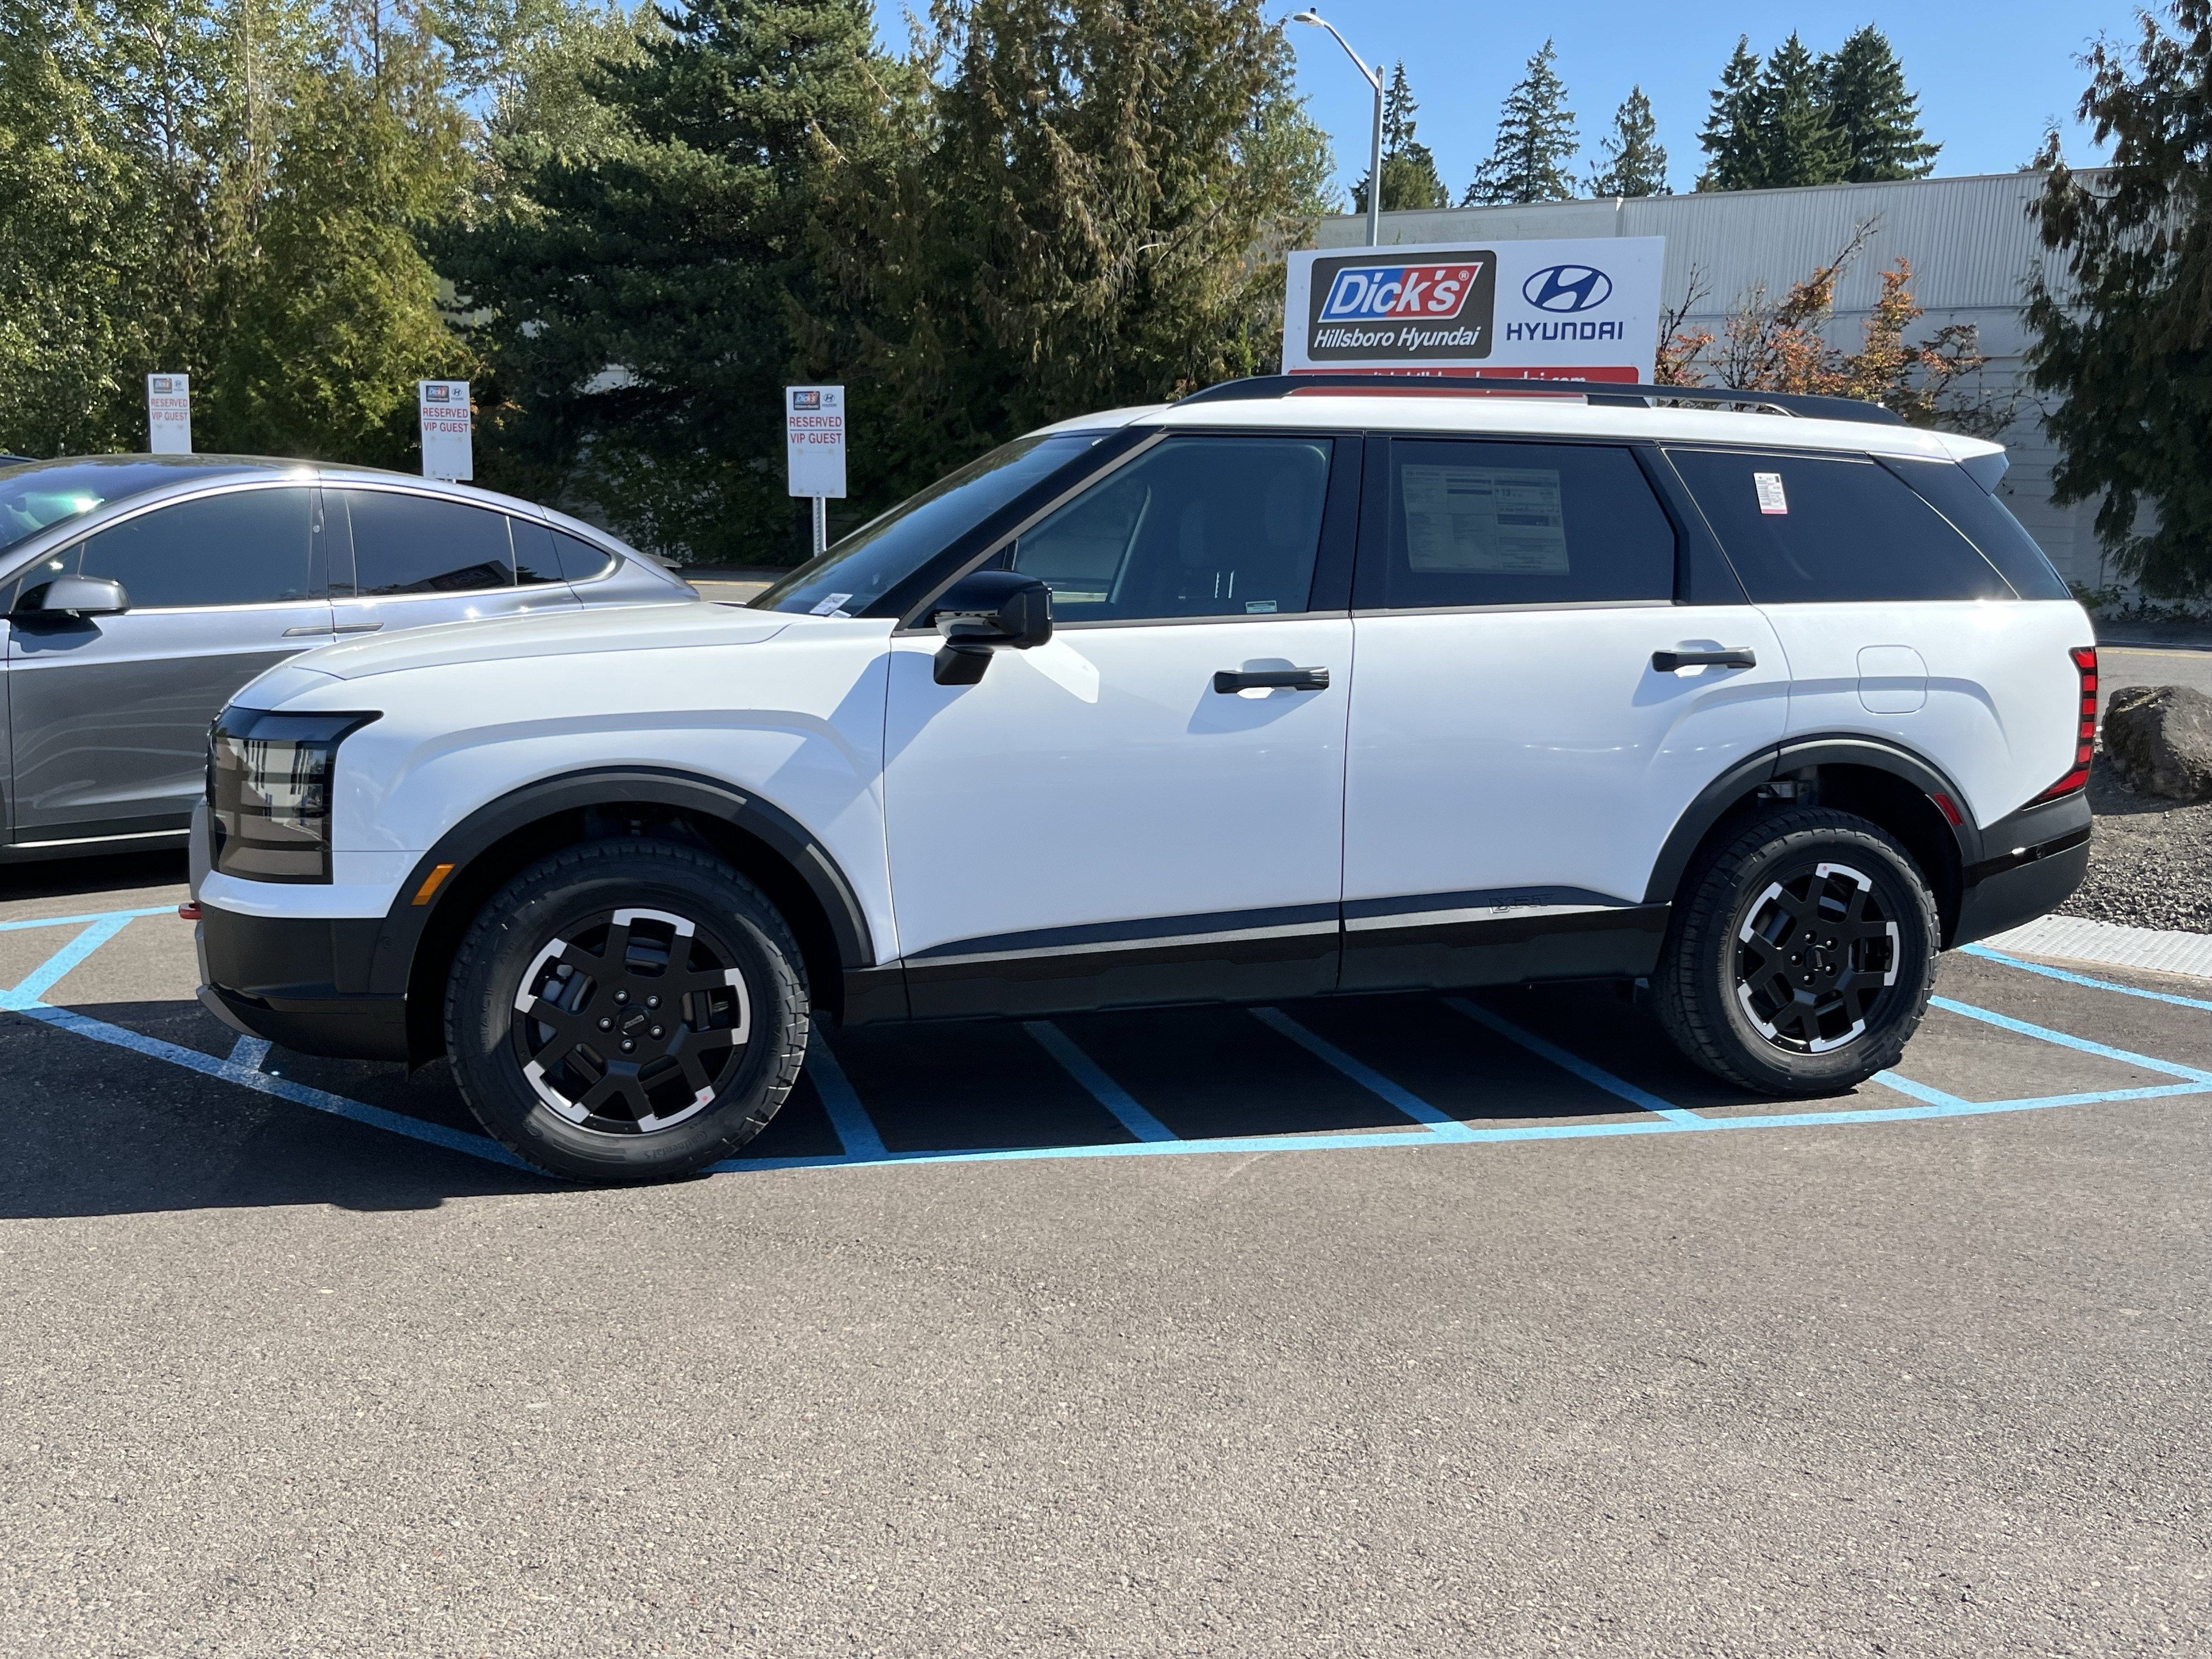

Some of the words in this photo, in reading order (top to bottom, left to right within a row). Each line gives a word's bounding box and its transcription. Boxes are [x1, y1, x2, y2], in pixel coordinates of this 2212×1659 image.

[1330, 270, 1460, 314] Dick's
[1506, 321, 1623, 341] HYUNDAI
[1313, 328, 1395, 348] Hillsboro
[1397, 326, 1482, 352] Hyundai
[151, 398, 188, 408] RESERVED
[151, 411, 163, 420] VIP
[165, 411, 188, 421] GUEST
[423, 408, 468, 418] RESERVED
[424, 421, 437, 432] VIP
[439, 422, 469, 433] GUEST
[789, 416, 842, 427] RESERVED
[791, 432, 805, 444] VIP
[808, 432, 842, 444] GUEST
